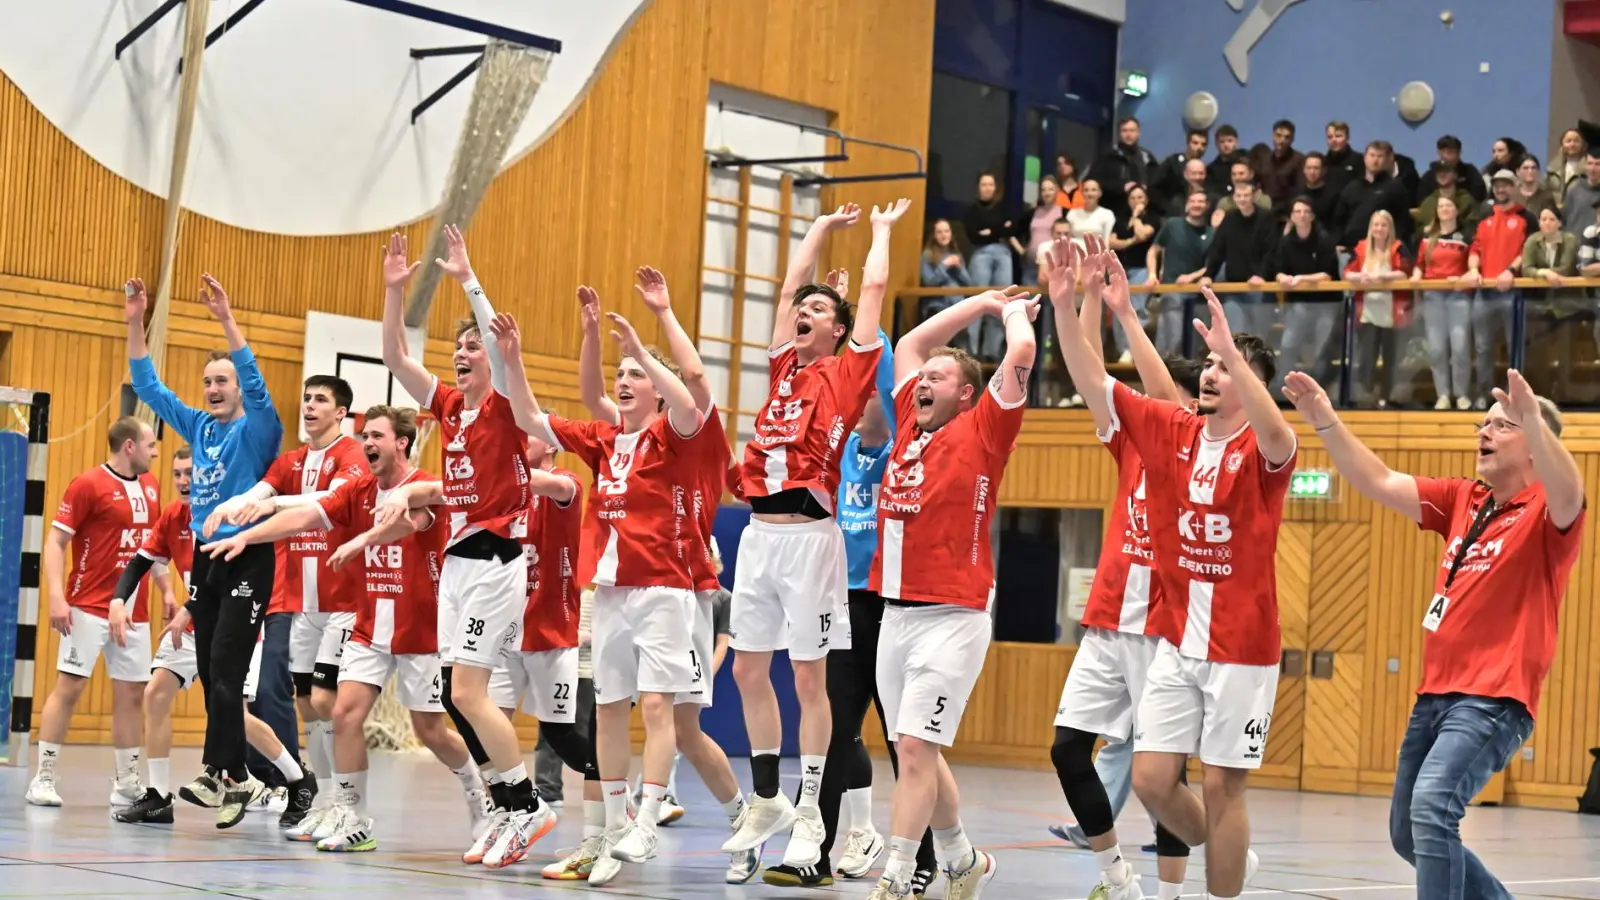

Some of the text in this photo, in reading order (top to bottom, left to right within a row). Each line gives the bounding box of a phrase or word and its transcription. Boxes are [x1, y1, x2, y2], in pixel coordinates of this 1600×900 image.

[613, 452, 631, 470] 19
[305, 468, 318, 487] 17
[887, 460, 925, 488] K+B
[1192, 464, 1217, 489] 44
[131, 497, 146, 513] 21
[1178, 507, 1233, 543] K+B
[289, 542, 328, 551] ELEKTRO
[364, 545, 403, 569] K+B
[366, 571, 393, 580] expert
[366, 583, 404, 594] ELEKTRO
[1429, 597, 1446, 619] A
[465, 617, 485, 637] 38
[819, 612, 831, 633] 15
[553, 683, 570, 700] 22
[933, 695, 948, 715] 5
